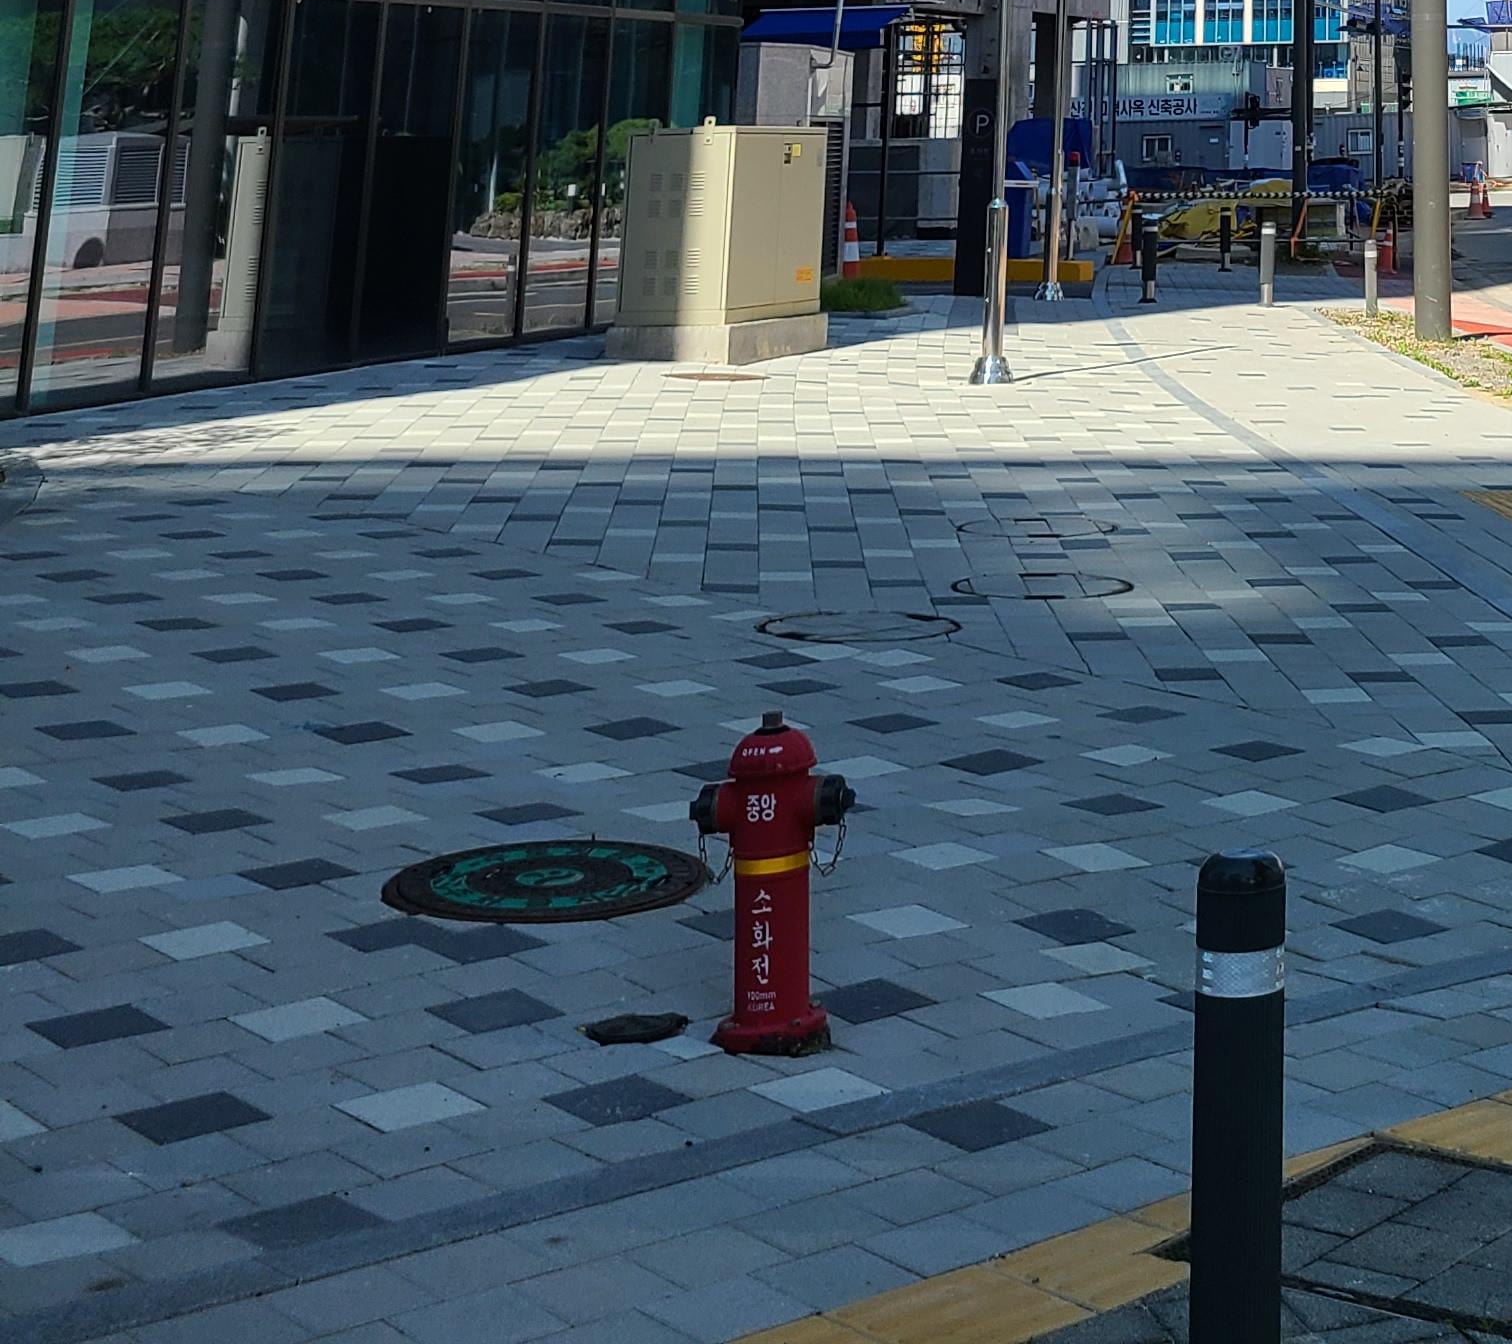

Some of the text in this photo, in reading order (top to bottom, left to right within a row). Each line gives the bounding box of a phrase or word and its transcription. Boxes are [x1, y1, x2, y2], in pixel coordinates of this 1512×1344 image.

[1148, 98, 1197, 116] 신축공사
[975, 114, 990, 134] P
[742, 746, 766, 757] OPEN
[746, 793, 777, 822] 중앙
[751, 889, 773, 985] 소화전
[747, 991, 777, 1001] 100mm
